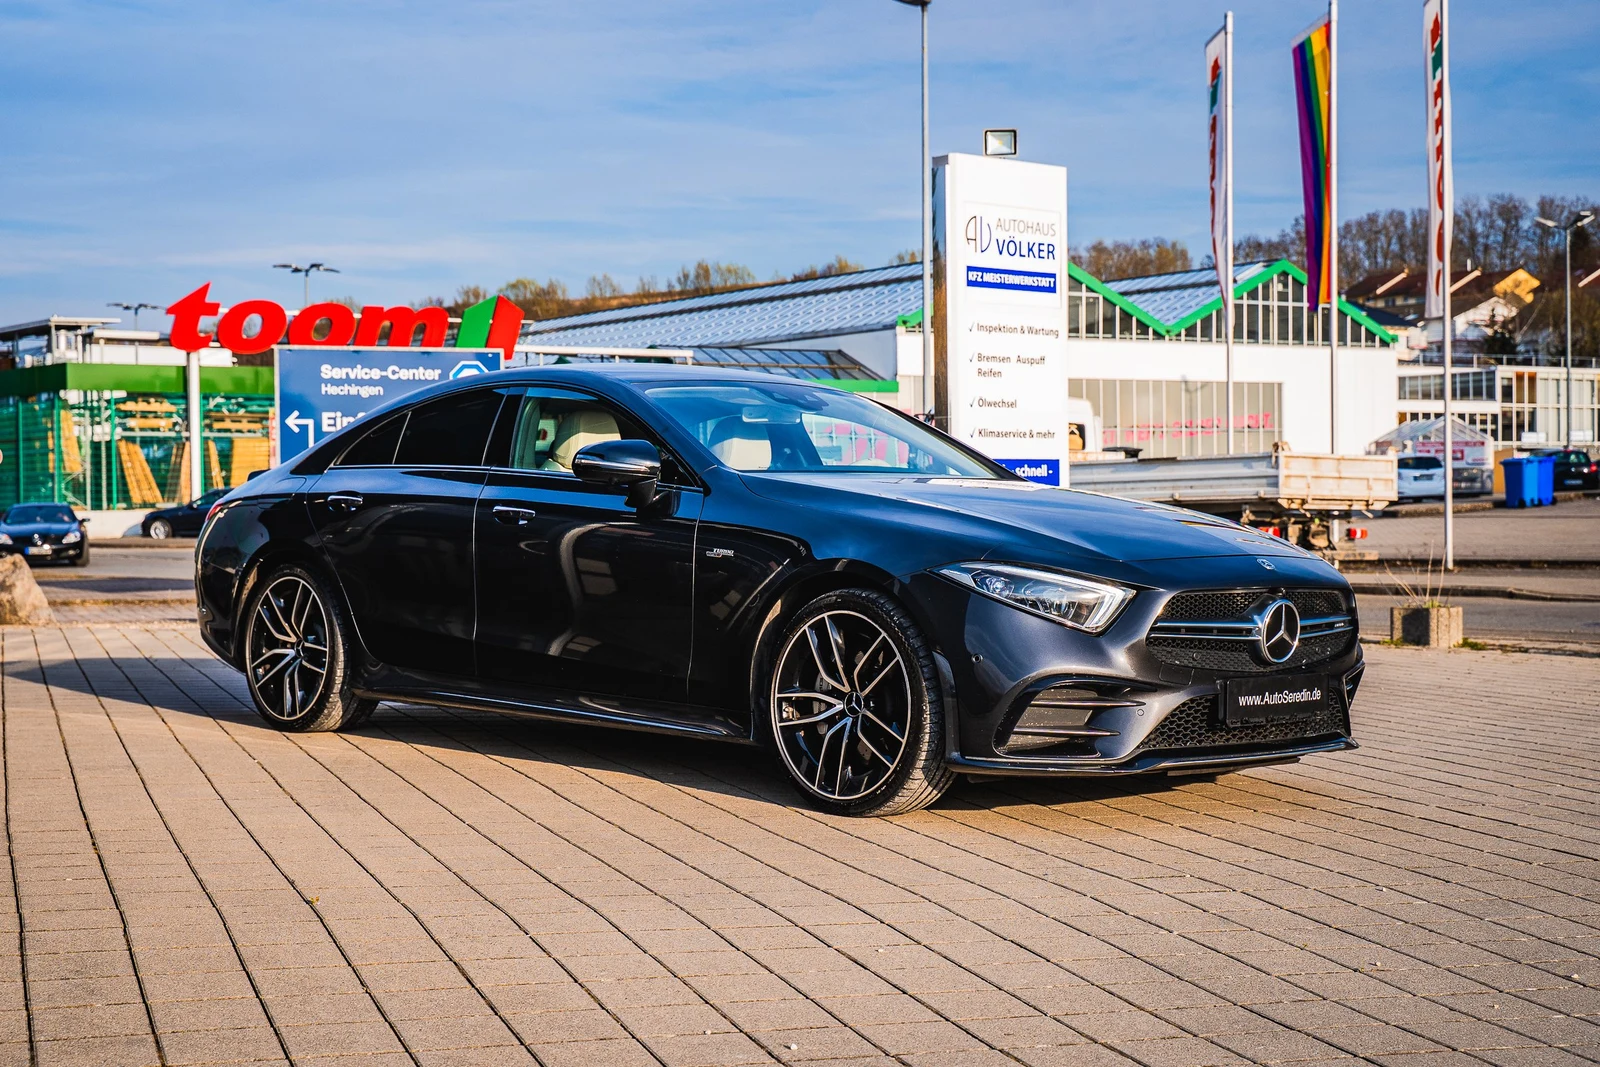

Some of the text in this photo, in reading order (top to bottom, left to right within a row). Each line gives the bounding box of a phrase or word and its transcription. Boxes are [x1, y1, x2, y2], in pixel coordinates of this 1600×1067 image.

[996, 218, 1056, 237] AUTOHAUS
[996, 236, 1056, 260] VÖLKER
[967, 271, 1056, 288] KFZ MEISTERWERKSTATT
[166, 282, 450, 354] toom
[976, 322, 1059, 339] Inspektion & Wartung
[977, 353, 1046, 367] Bremsen Auspuff
[320, 364, 441, 381] Service-Center
[977, 368, 1002, 378] Reifen
[321, 383, 384, 398] Hechingen
[977, 396, 1017, 409] Ölwechsel
[978, 429, 1056, 439] Klimaservice & mehr
[1015, 463, 1048, 477] schnell
[1238, 687, 1322, 707] www.AutoSeredin.de
